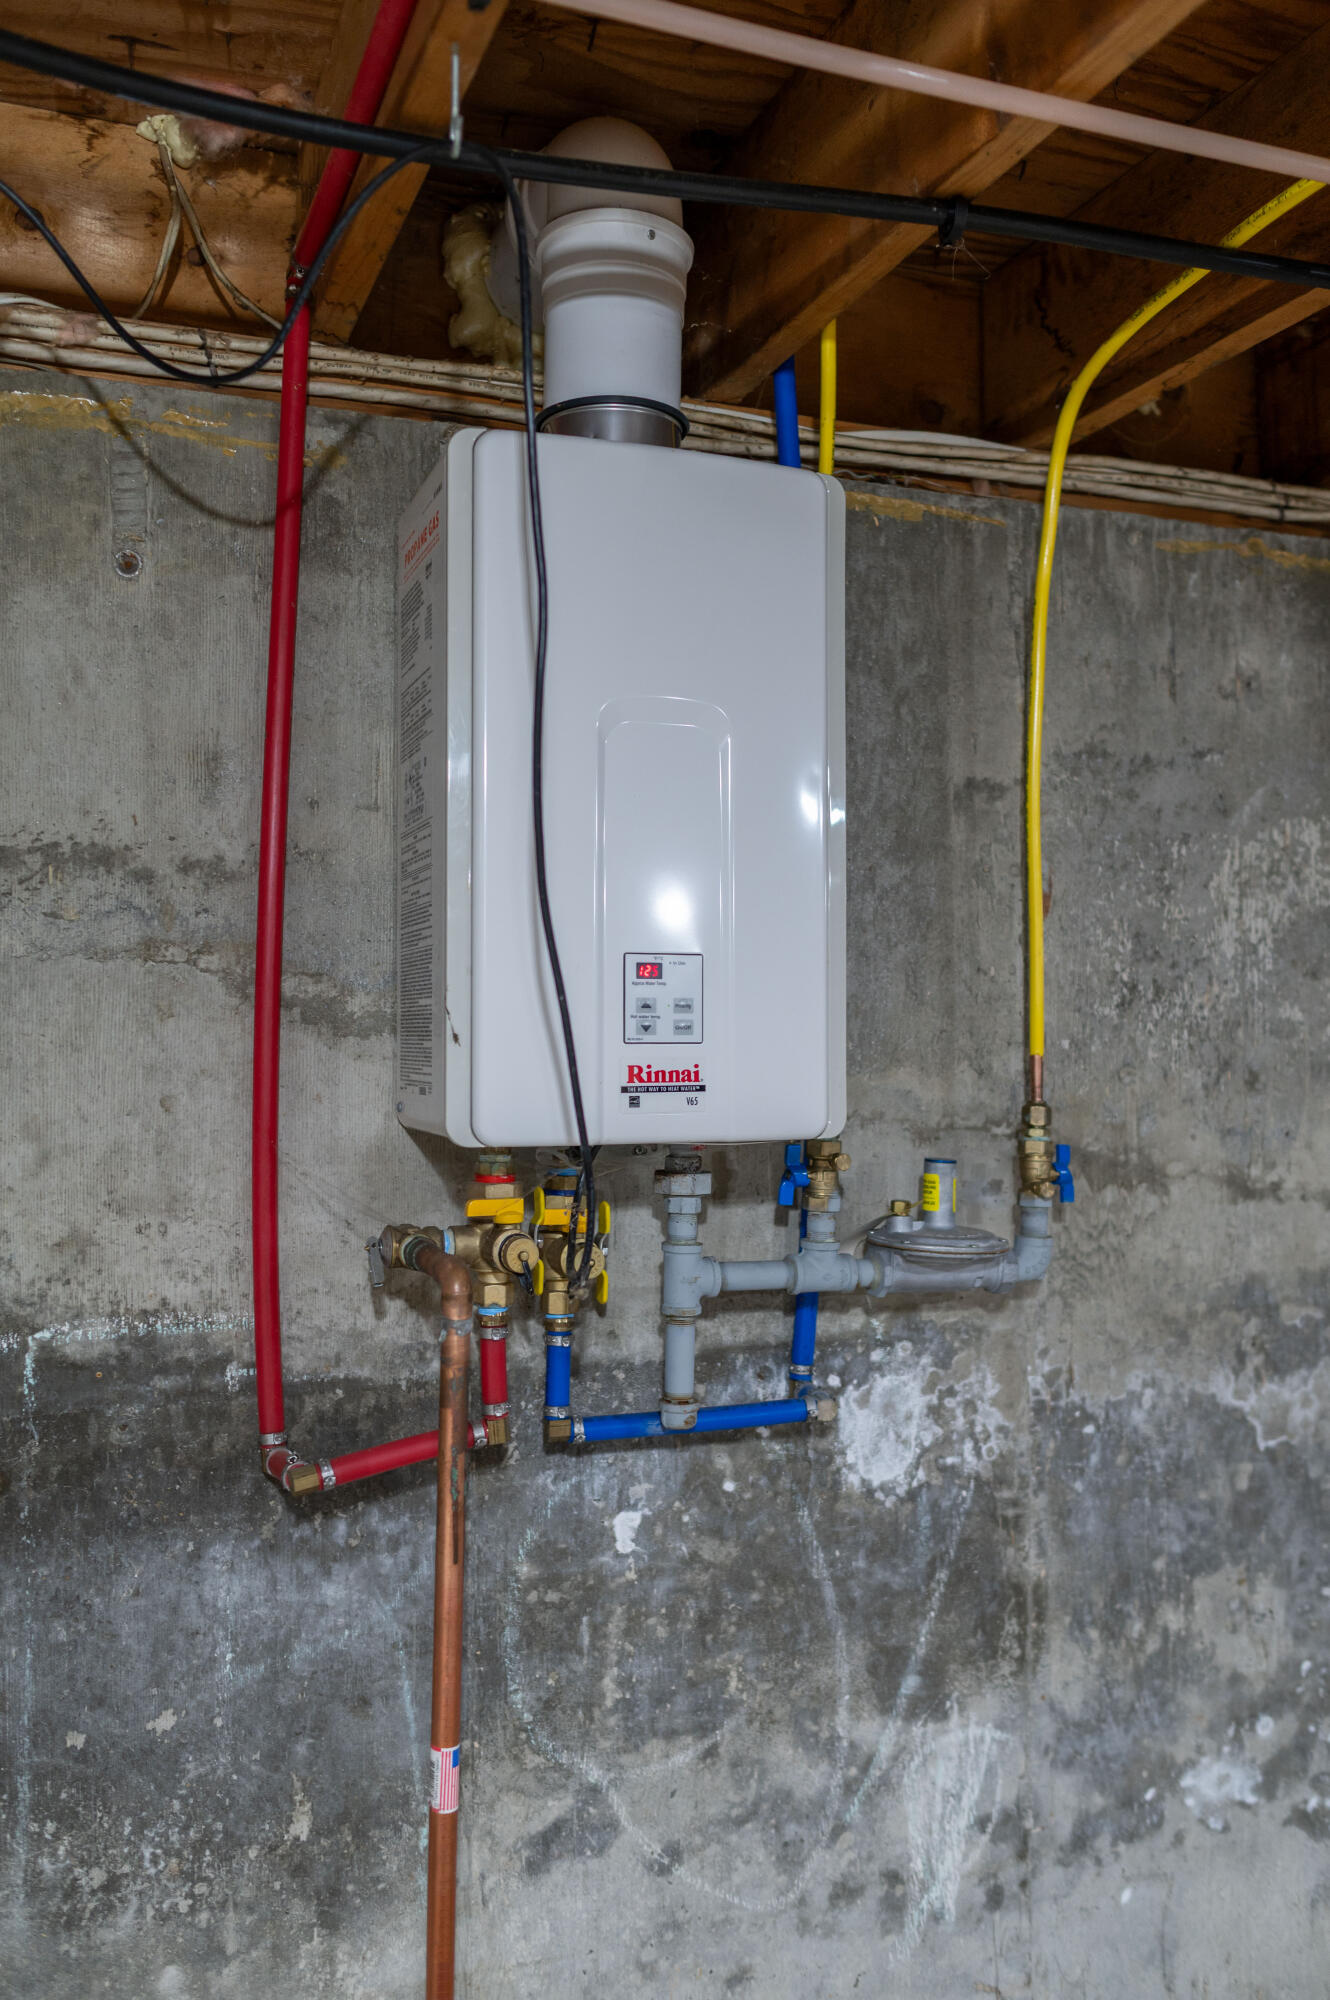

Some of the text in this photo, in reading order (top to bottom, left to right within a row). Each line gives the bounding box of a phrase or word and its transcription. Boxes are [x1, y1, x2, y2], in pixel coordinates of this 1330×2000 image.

[404, 527, 427, 568] PROPANE
[428, 510, 440, 537] GAS
[639, 964, 659, 977] 125
[627, 1064, 701, 1083] Rinnai
[686, 1096, 699, 1106] V65
